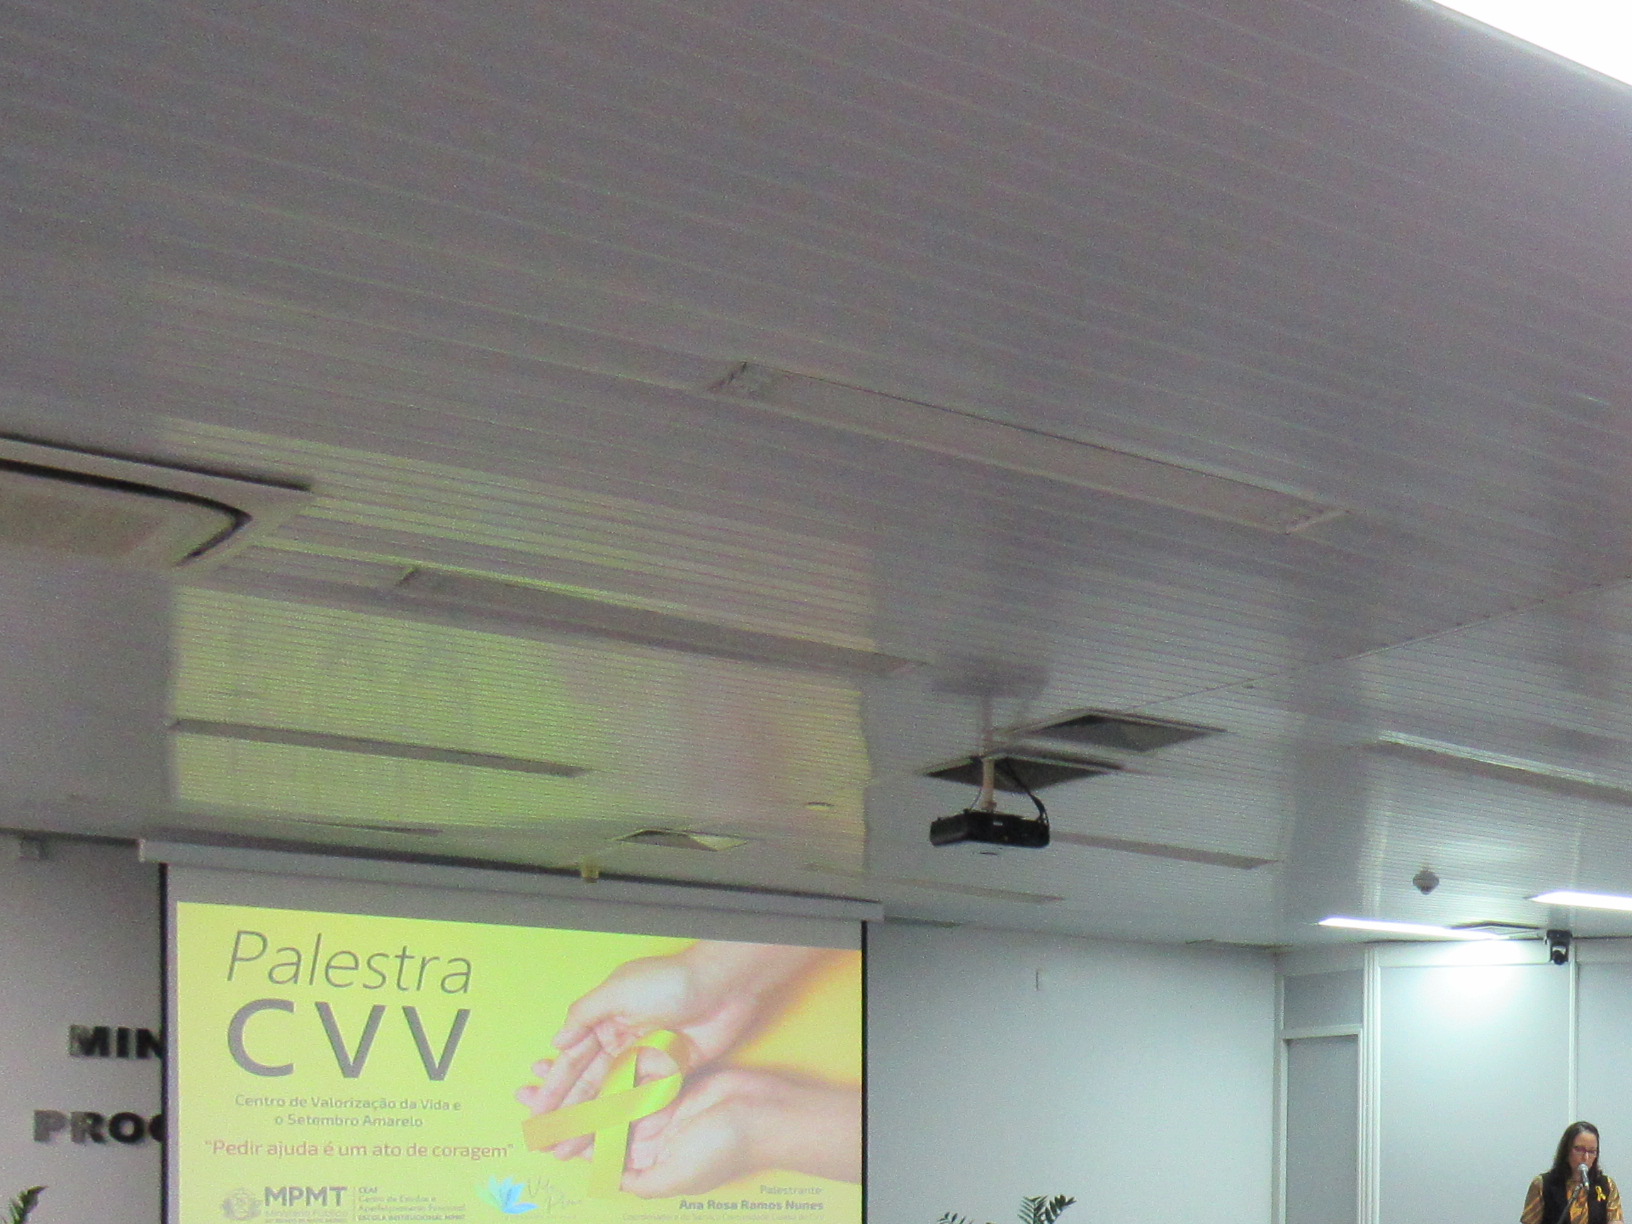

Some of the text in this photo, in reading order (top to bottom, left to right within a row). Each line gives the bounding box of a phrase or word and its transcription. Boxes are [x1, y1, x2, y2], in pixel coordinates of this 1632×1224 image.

[226, 929, 473, 994] Palestra
[227, 997, 471, 1081] CVV
[235, 1094, 462, 1112] Centro de Valorização da Vida e
[275, 1113, 424, 1128] o Setembro Amarelo
[267, 1141, 319, 1159] ajuda
[323, 1141, 335, 1156] é
[338, 1146, 368, 1157] um
[372, 1143, 402, 1158] ato
[406, 1143, 428, 1158] de
[264, 1186, 348, 1207] MPMT
[760, 1184, 823, 1195] Palestrante
[679, 1199, 824, 1210] Ana Rosa Ramos Nunes
